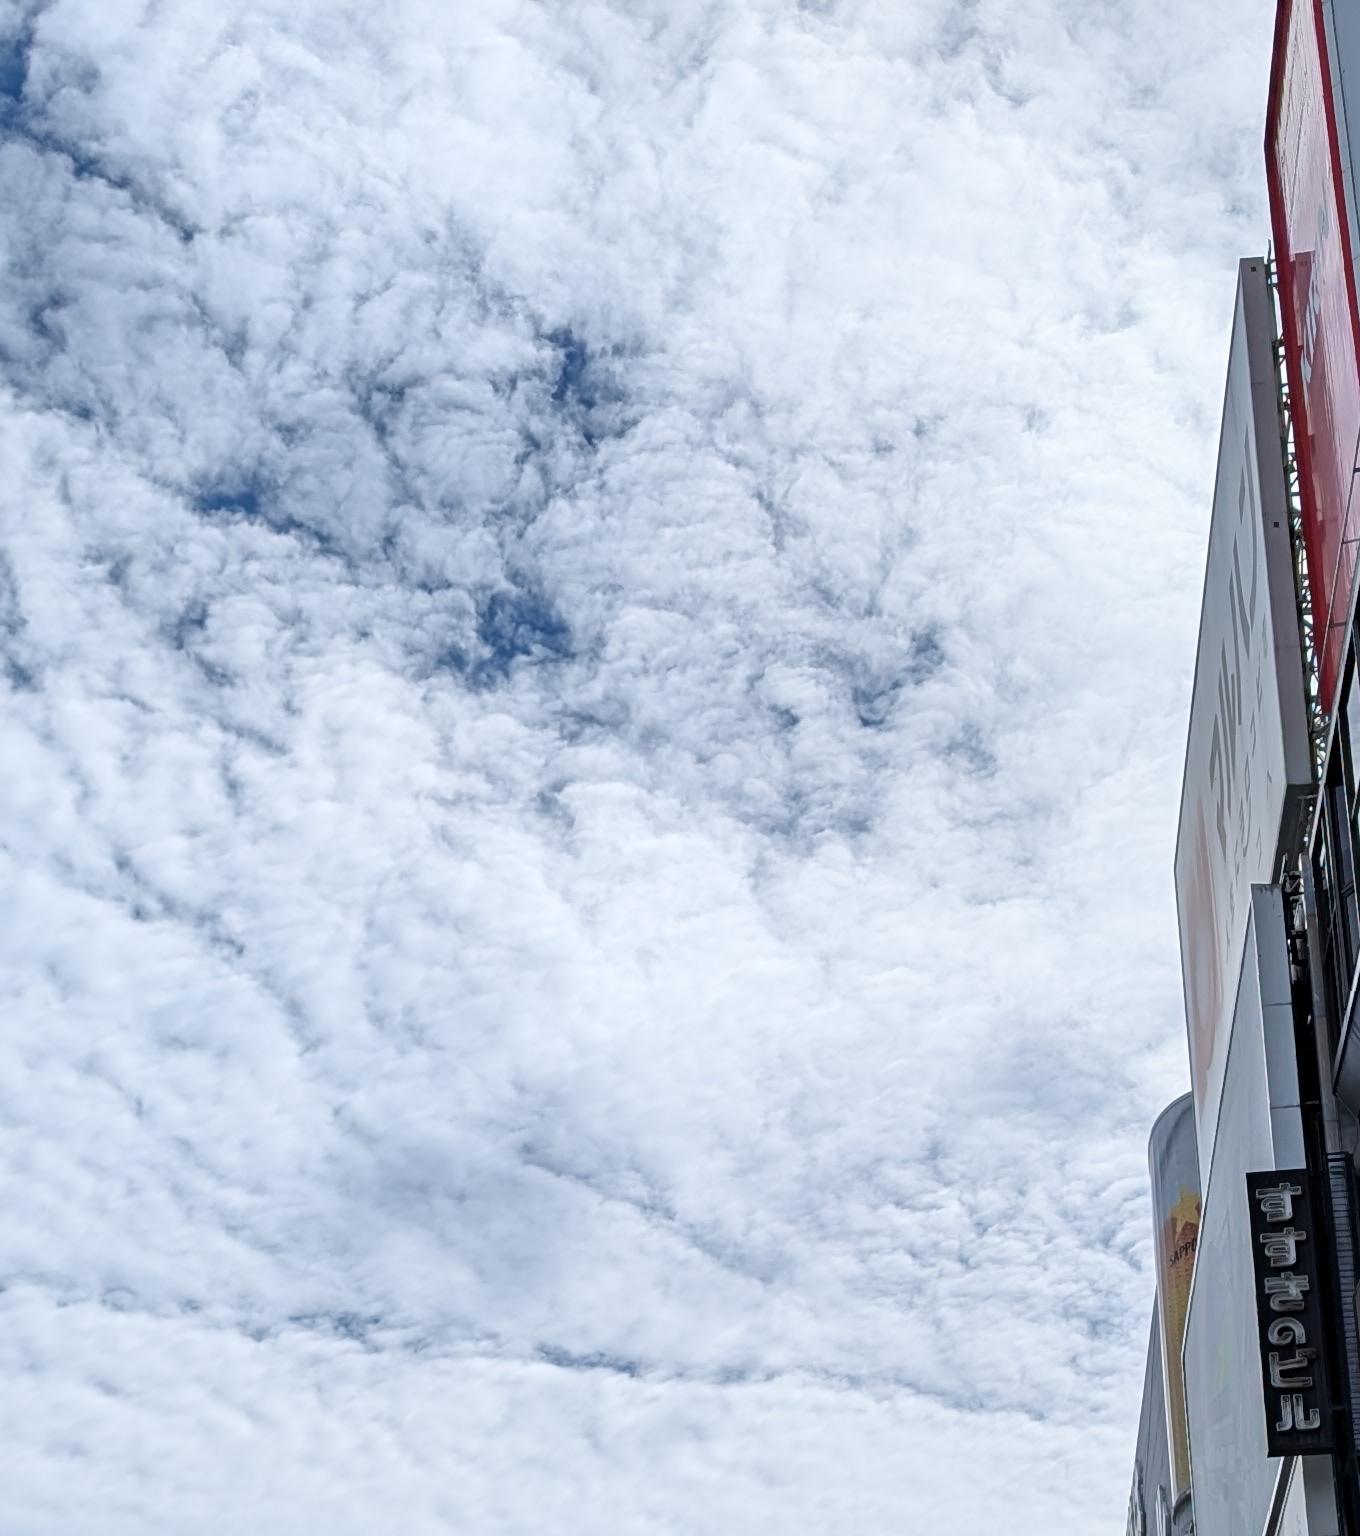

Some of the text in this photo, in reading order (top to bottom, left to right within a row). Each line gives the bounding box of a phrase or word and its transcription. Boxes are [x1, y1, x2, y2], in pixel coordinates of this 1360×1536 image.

[1255, 1181, 1321, 1433] すすきのビル
